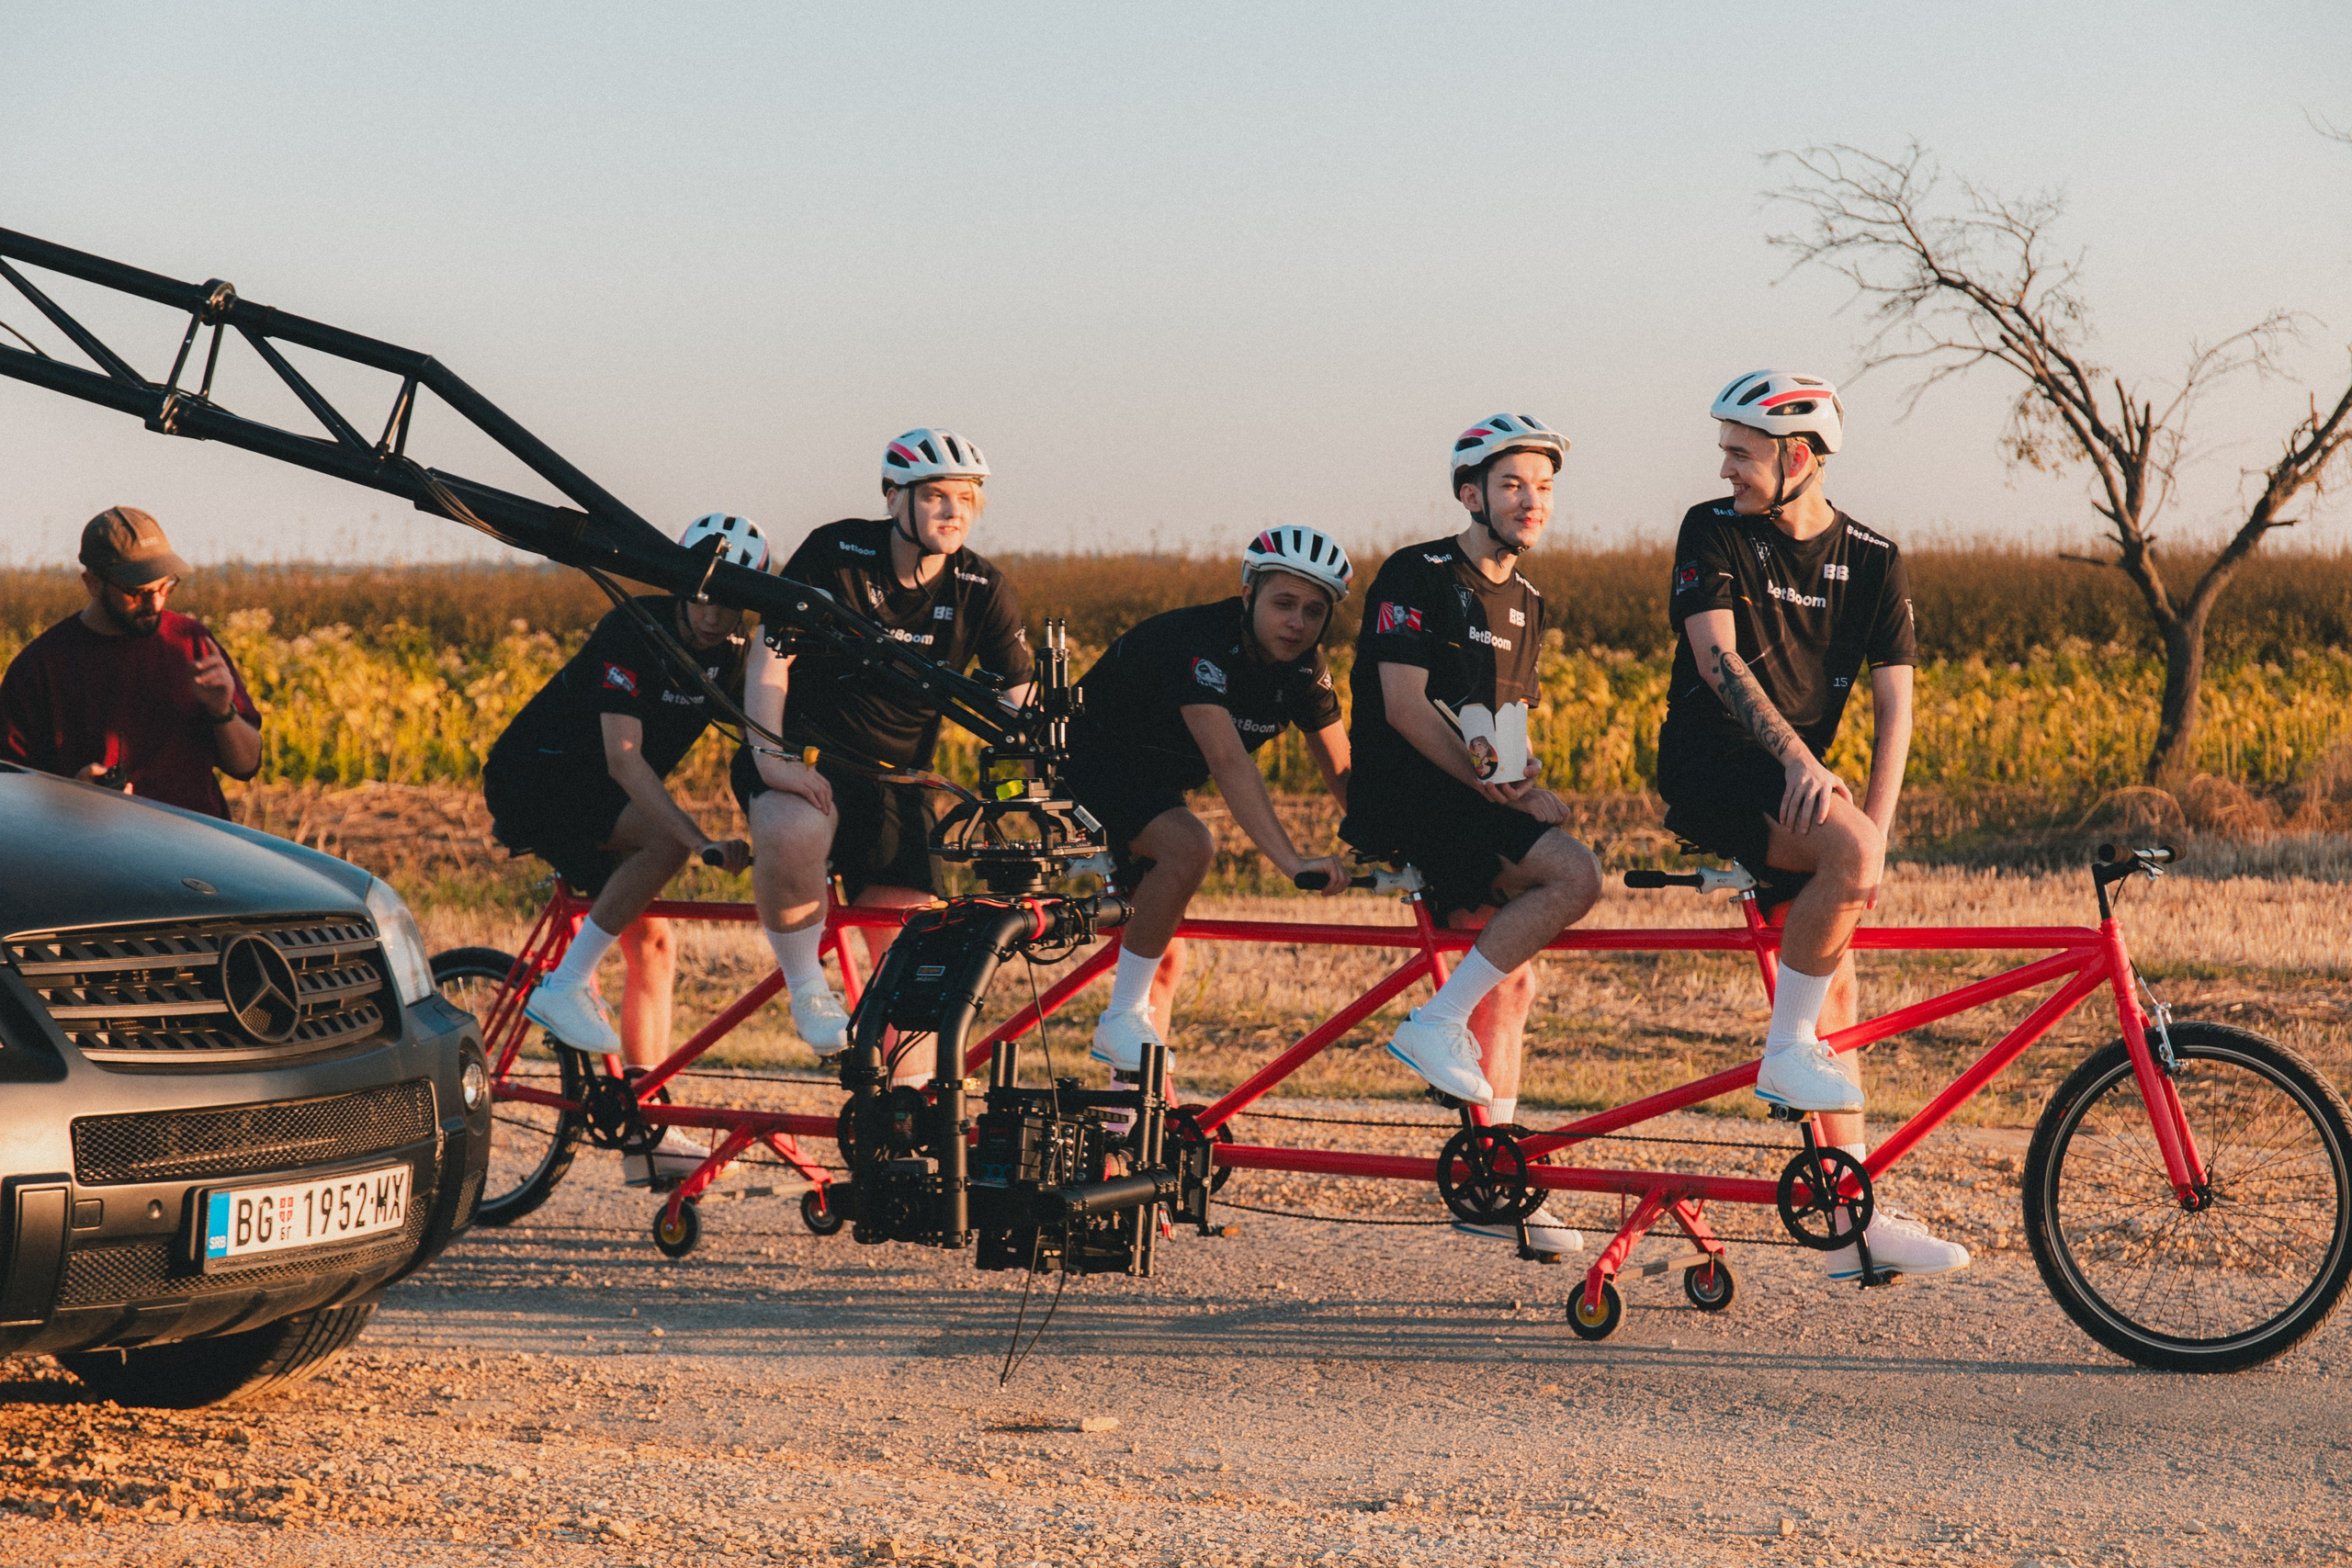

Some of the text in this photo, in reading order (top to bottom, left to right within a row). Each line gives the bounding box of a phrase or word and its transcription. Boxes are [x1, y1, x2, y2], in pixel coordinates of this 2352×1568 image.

[1846, 524, 1890, 548] BetBoom
[1823, 563, 1849, 581] BB
[1509, 607, 1526, 627] BB
[1469, 626, 1512, 651] BetBoom
[1833, 677, 1849, 687] 15
[235, 1195, 275, 1247] BG
[209, 1235, 226, 1250] SRB
